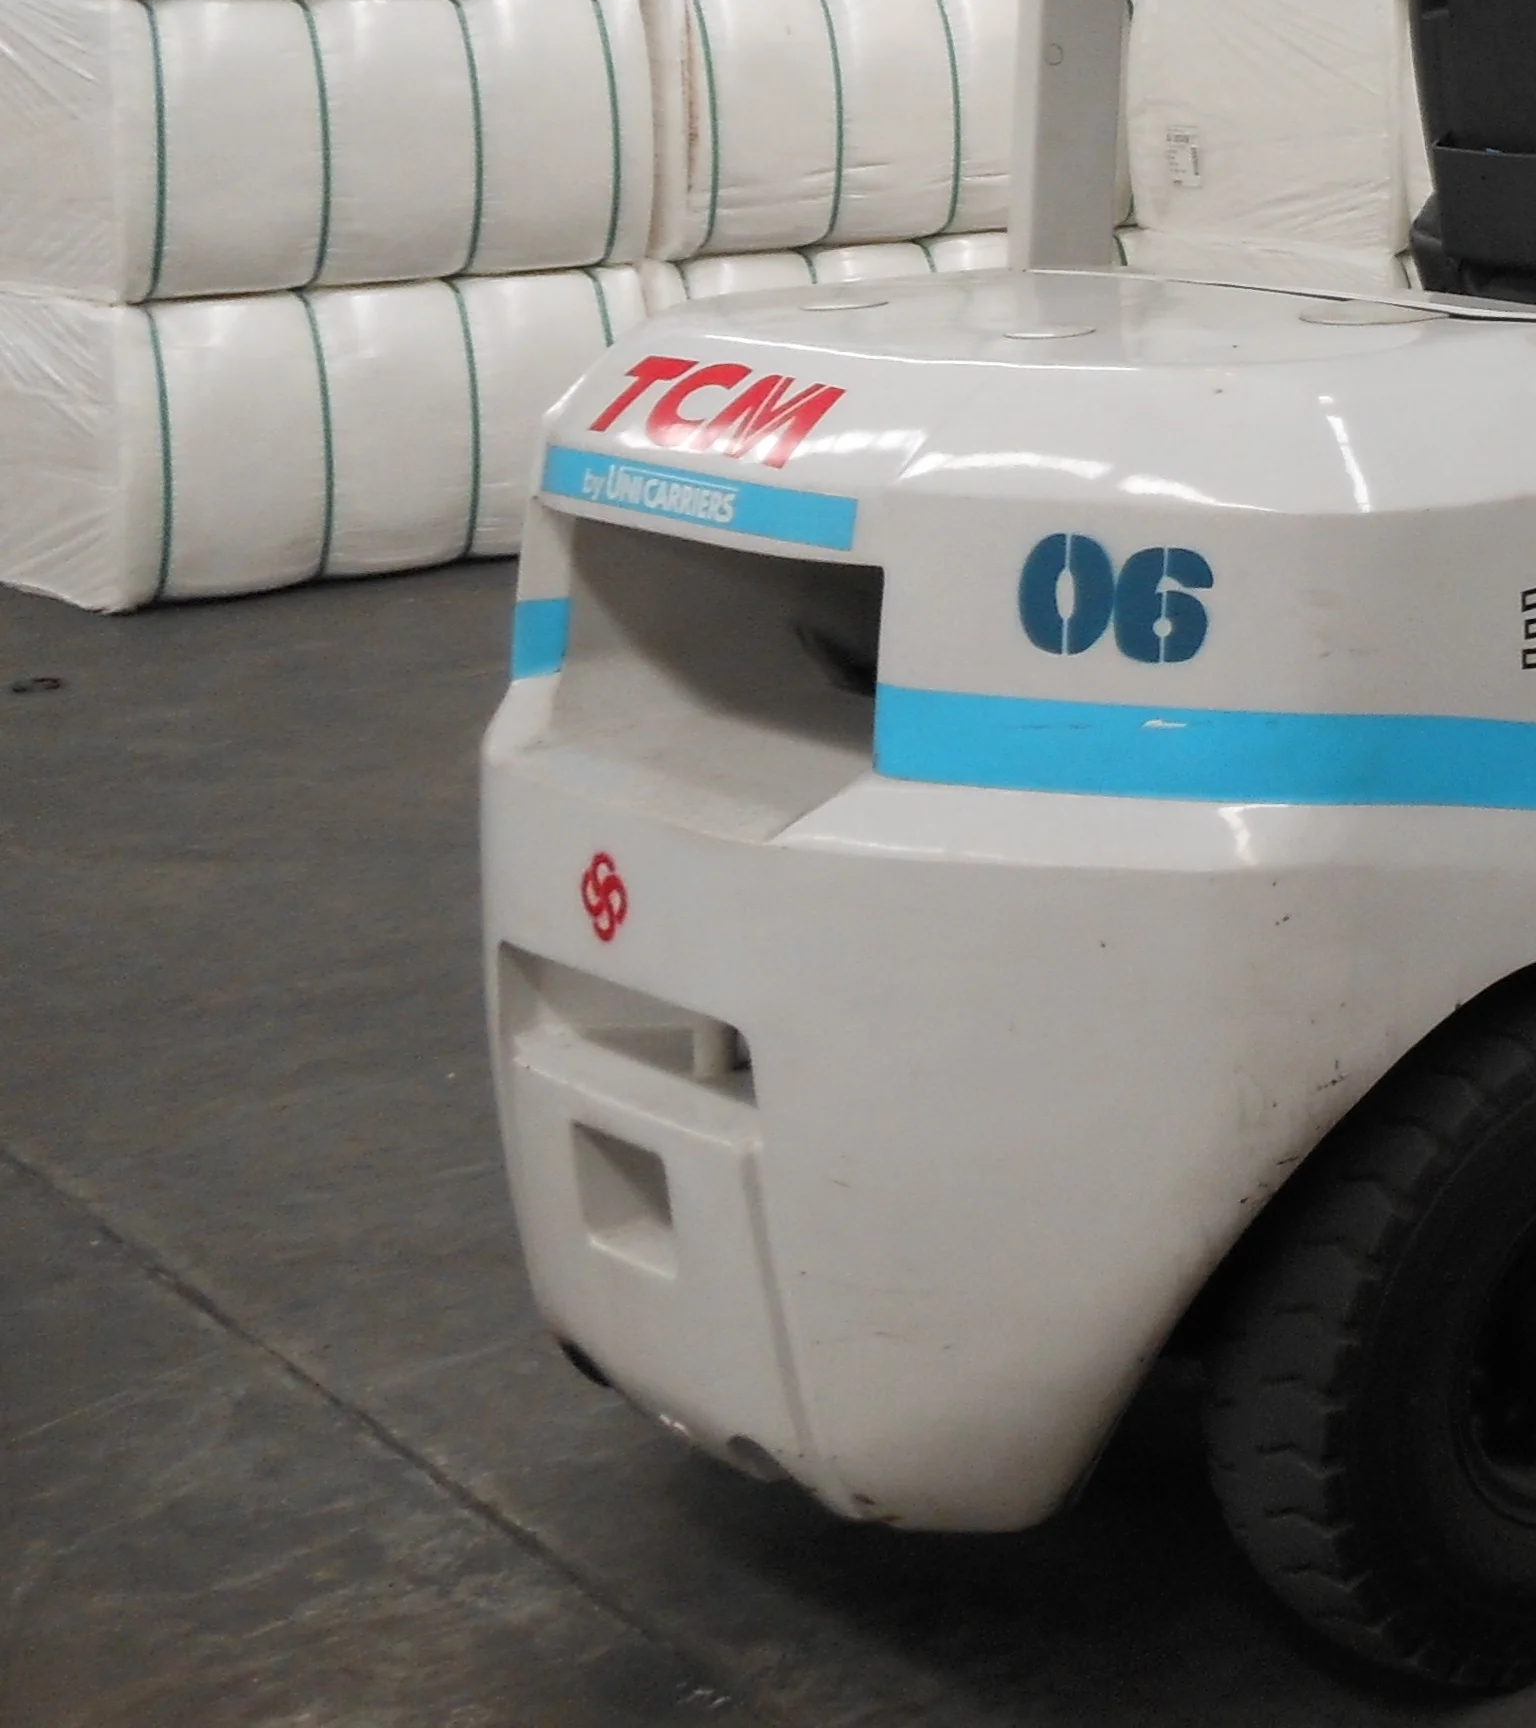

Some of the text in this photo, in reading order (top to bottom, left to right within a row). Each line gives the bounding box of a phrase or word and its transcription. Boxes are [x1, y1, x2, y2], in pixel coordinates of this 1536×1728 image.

[588, 354, 848, 470] TCM
[583, 468, 606, 501] by
[1018, 532, 1214, 664] 06
